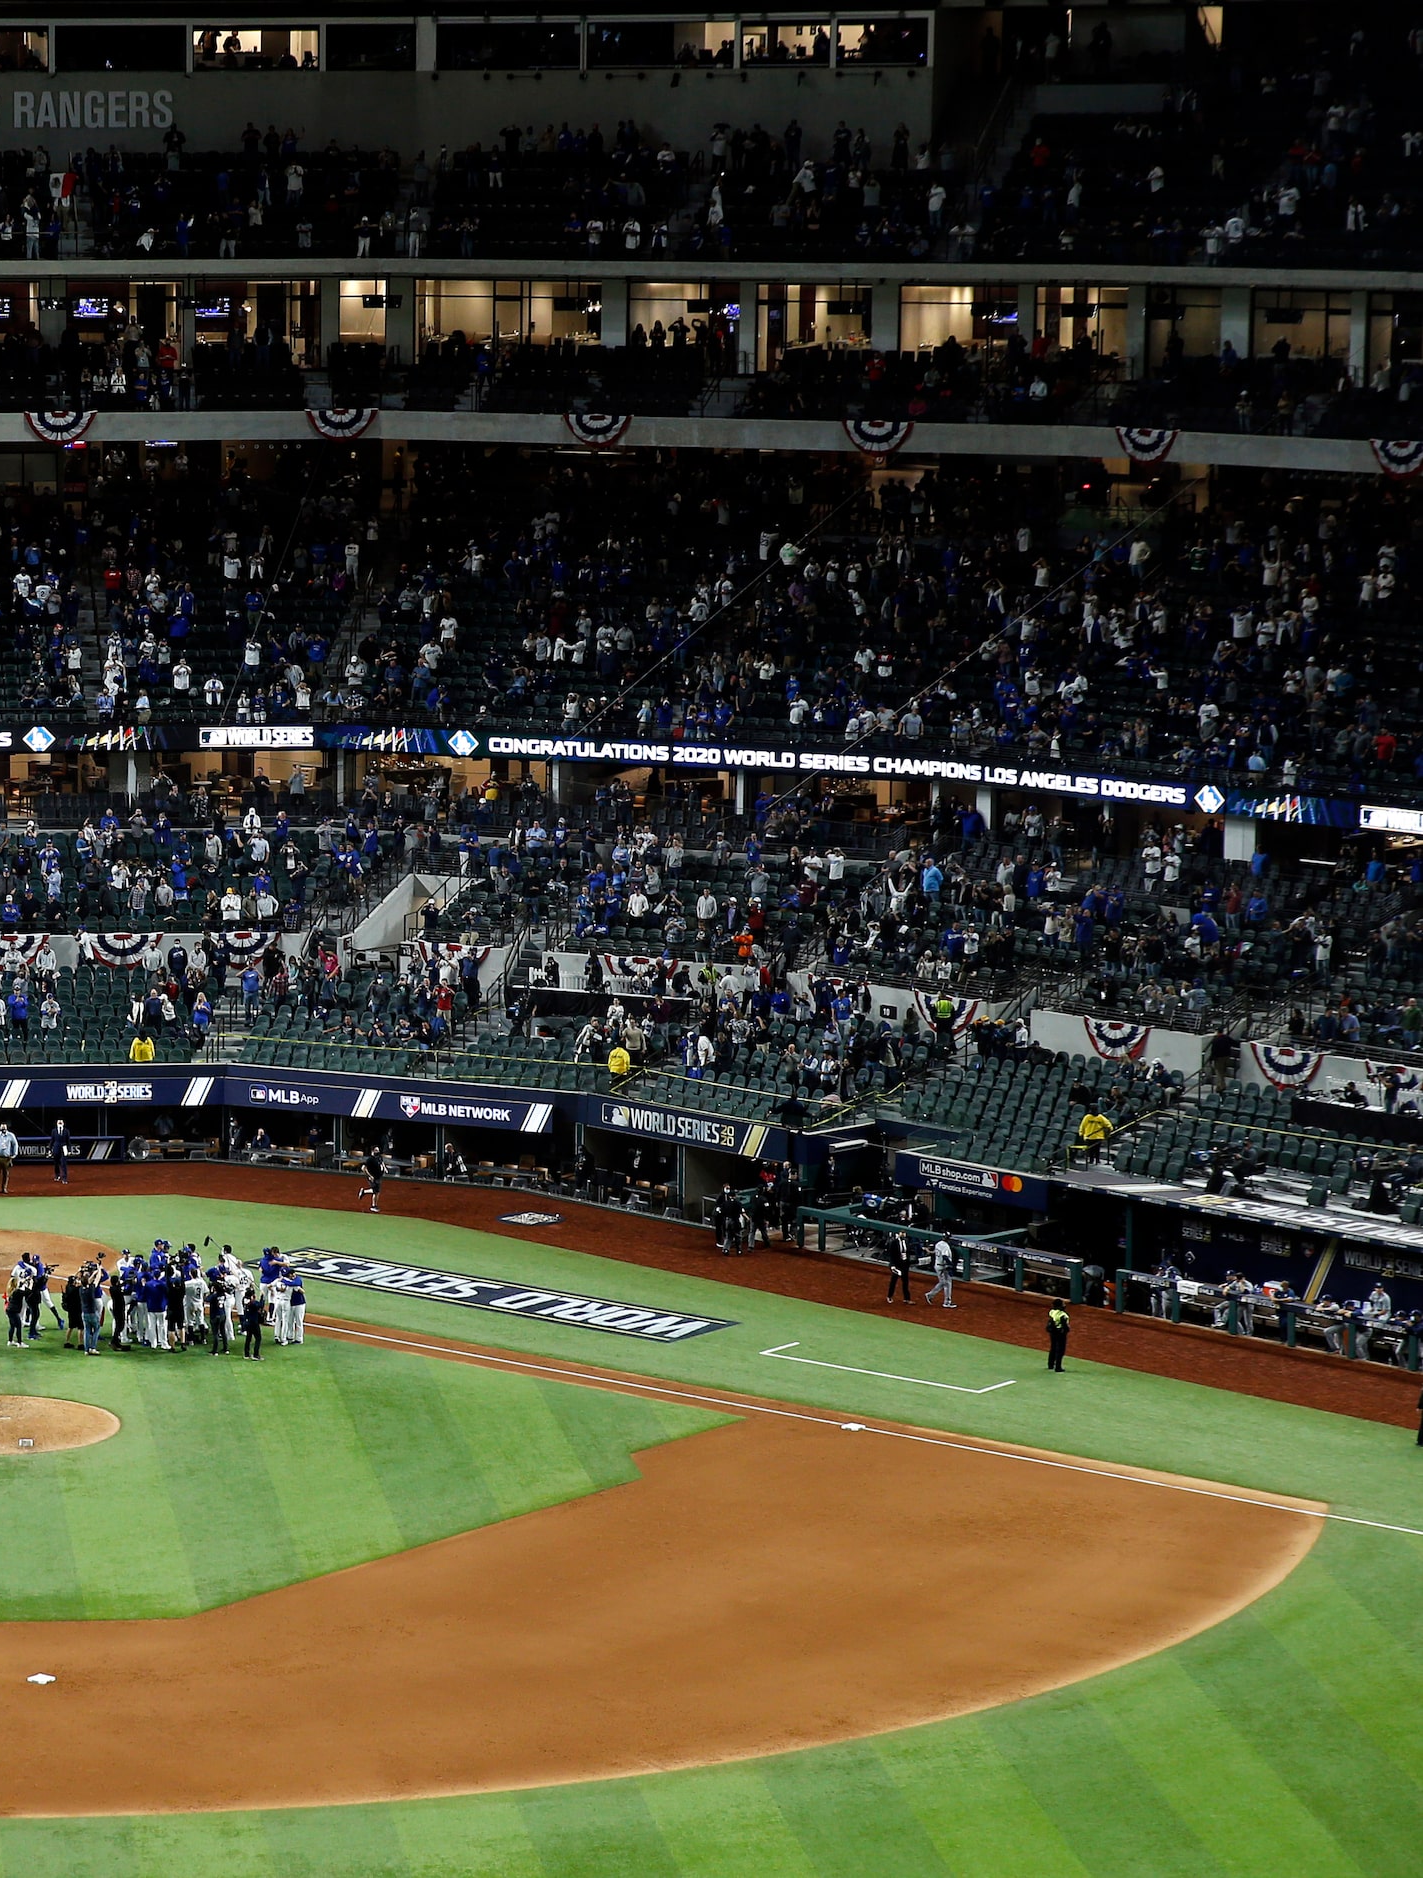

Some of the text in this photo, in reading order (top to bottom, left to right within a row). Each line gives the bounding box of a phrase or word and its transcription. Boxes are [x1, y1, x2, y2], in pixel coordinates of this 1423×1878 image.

[13, 89, 174, 130] RANGERS
[227, 728, 272, 746] WORLD
[488, 737, 1186, 804] CONGRATULATIONS 2020 WORLD SERIES CHAMPIONS LOS ANGELES DODGERS
[66, 1085, 153, 1099] WORLD SERIES
[104, 1080, 117, 1089] 20
[104, 1095, 118, 1104] 20
[268, 1089, 320, 1106] MLB App
[421, 1102, 511, 1122] MLB NETWORK
[630, 1107, 720, 1144] WORLD SERIES
[720, 1124, 735, 1136] 20
[720, 1135, 735, 1147] 20
[19, 1145, 46, 1156] WORLD
[939, 1181, 962, 1194] Fanatics
[961, 1186, 993, 1199] Experience
[1344, 1249, 1383, 1270] WORLD
[239, 1275, 251, 1286] 45
[196, 1287, 203, 1300] 3
[294, 1258, 711, 1341] WORLD SERIES
